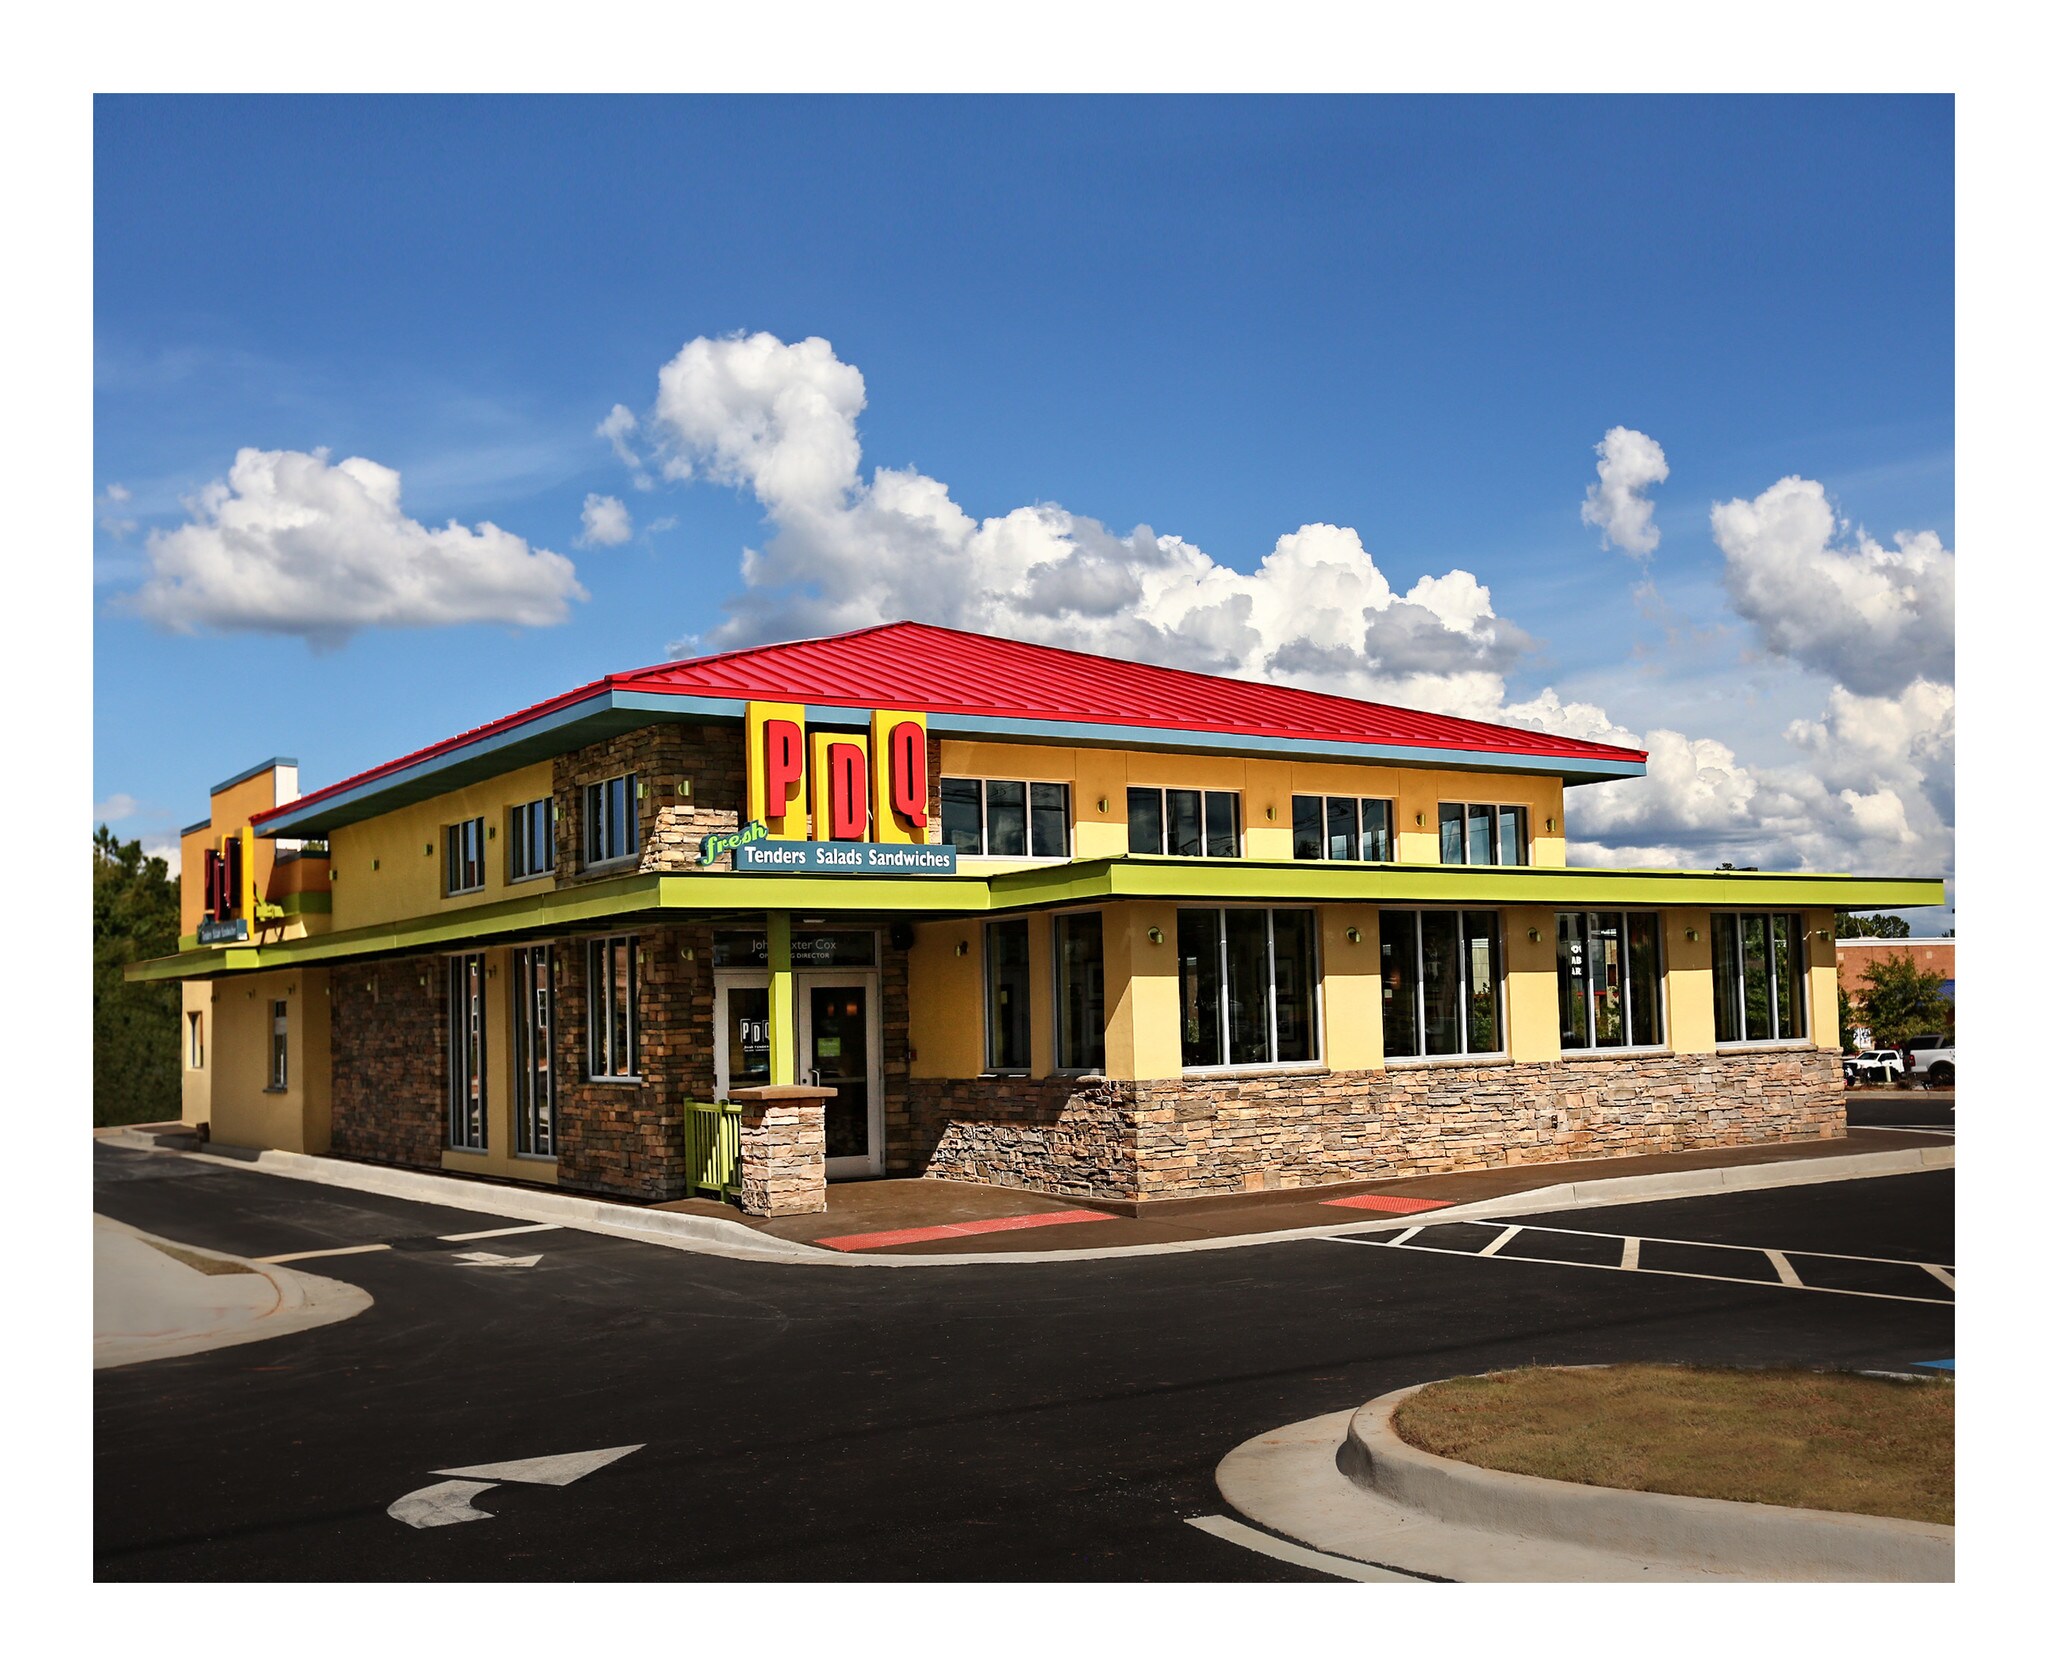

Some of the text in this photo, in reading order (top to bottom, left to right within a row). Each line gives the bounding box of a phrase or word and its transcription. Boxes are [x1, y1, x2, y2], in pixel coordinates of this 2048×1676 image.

[764, 719, 927, 839] PDQ
[702, 821, 768, 866] fresh
[744, 847, 950, 867] Tenders Salads Sandwiches
[815, 938, 837, 950] Cox
